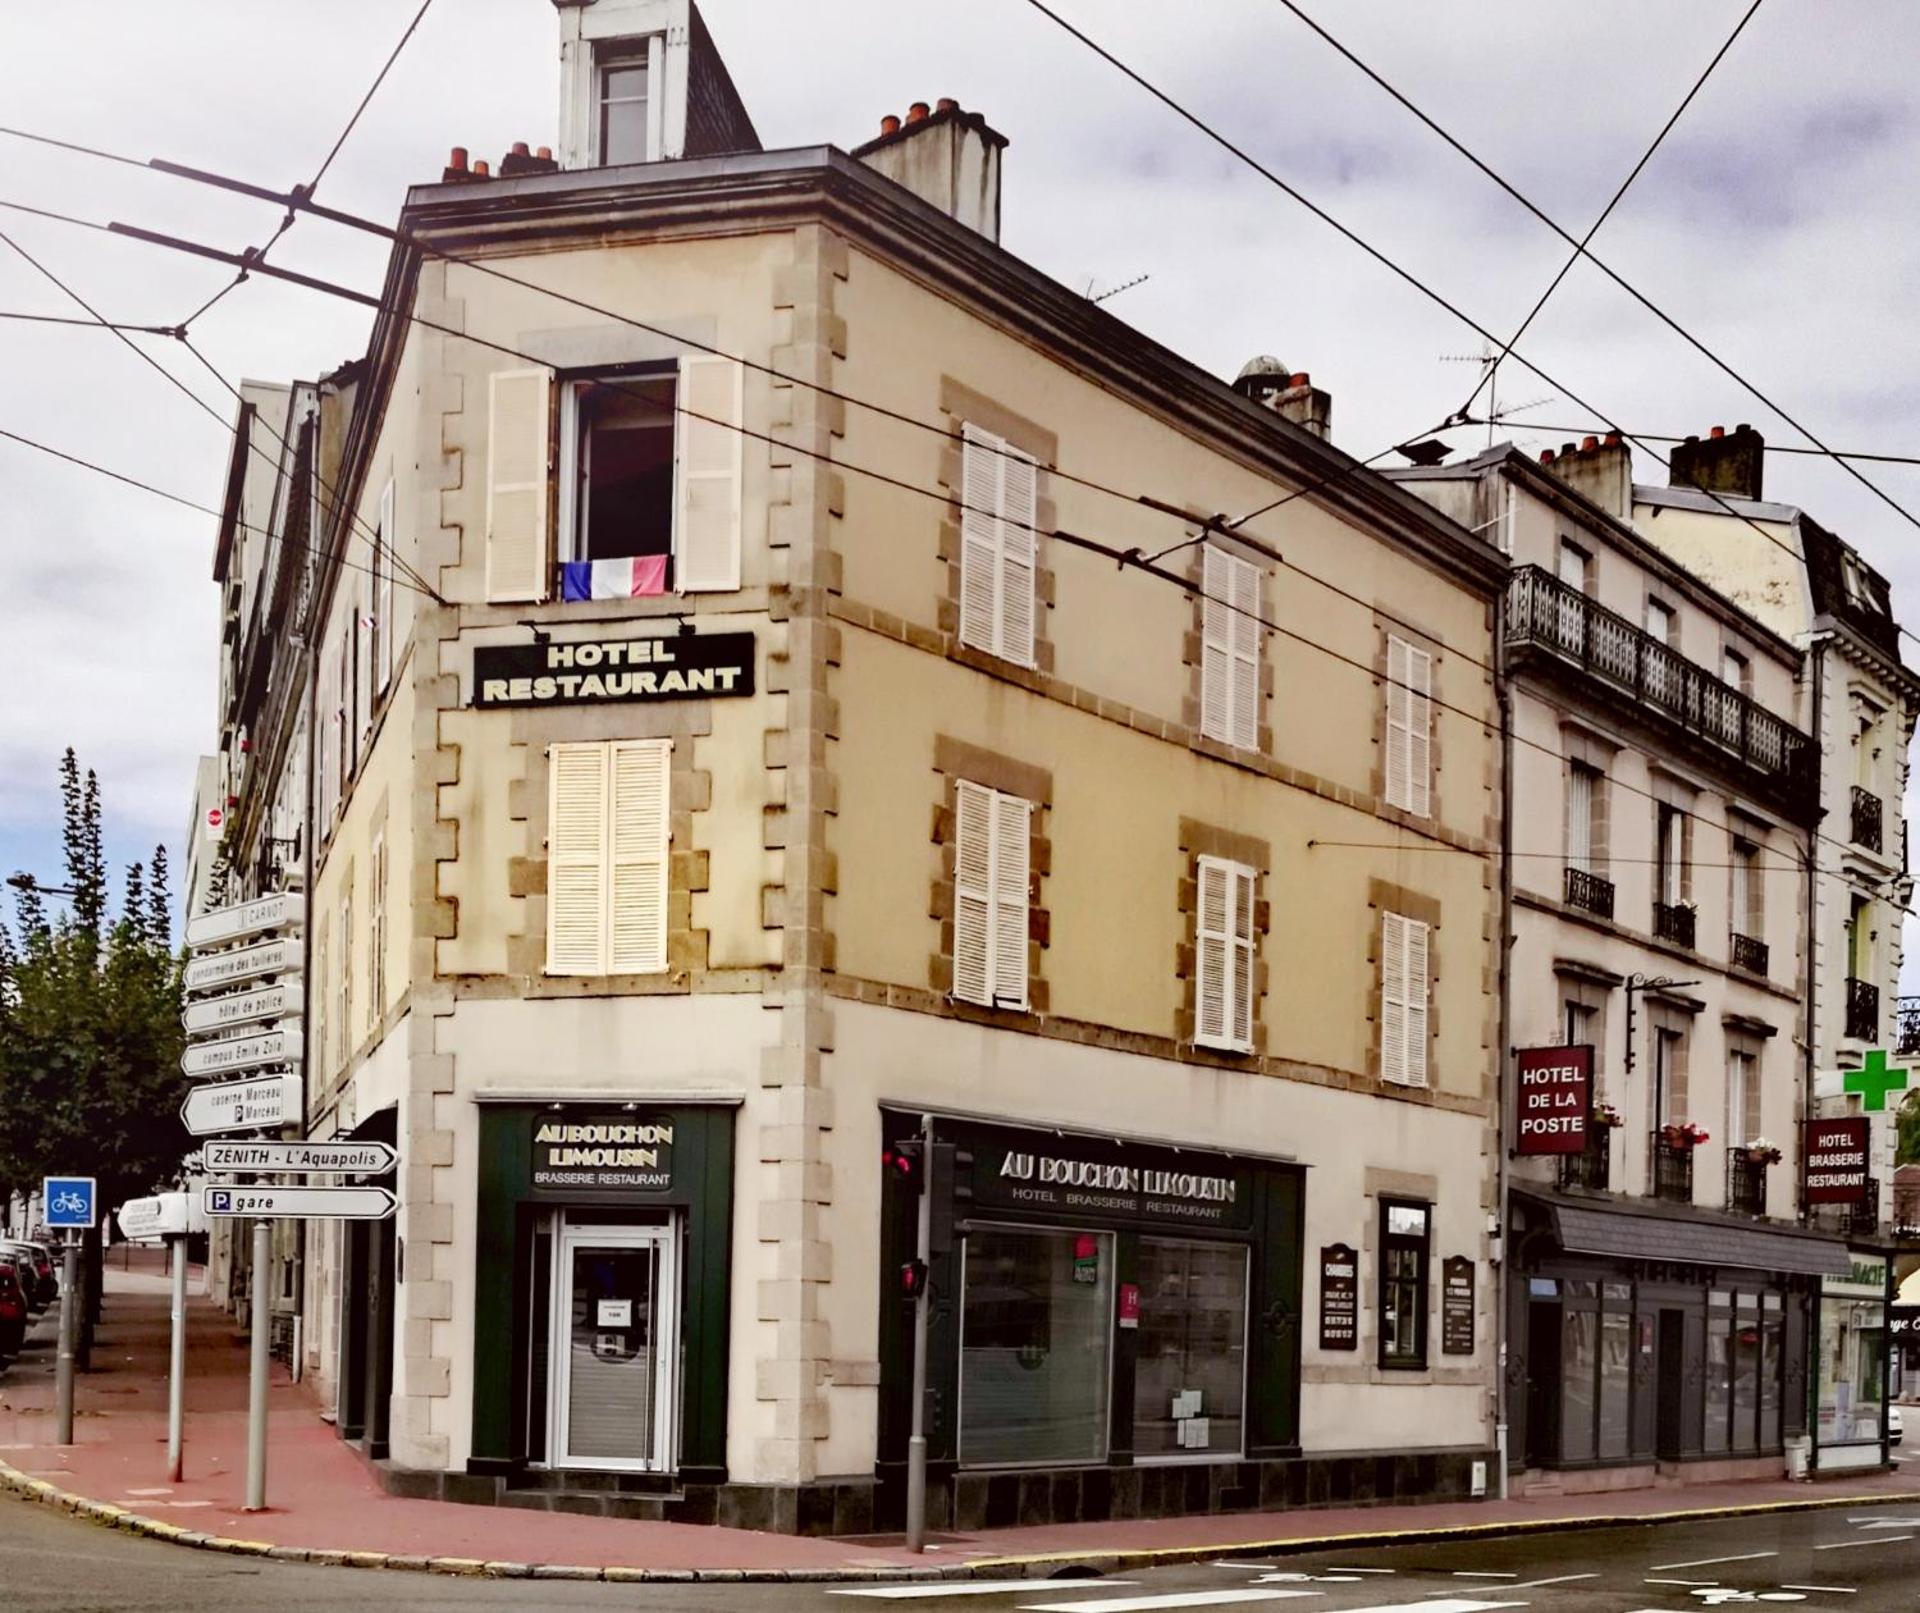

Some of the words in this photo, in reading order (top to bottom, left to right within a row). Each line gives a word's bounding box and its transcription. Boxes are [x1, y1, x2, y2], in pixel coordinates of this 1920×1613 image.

[548, 640, 675, 668] HOTEL
[483, 667, 742, 701] RESTAURANT
[249, 901, 284, 922] CARNOT
[242, 1001, 253, 1013] de
[255, 995, 282, 1013] police
[203, 1049, 233, 1066] campus
[262, 1038, 282, 1055] Zola
[1523, 1066, 1585, 1085] HOTEL
[246, 1087, 281, 1101] Marceau
[1528, 1093, 1550, 1108] DE
[1555, 1092, 1576, 1107] LA
[245, 1105, 281, 1119] Marceau
[1522, 1116, 1584, 1134] POSTE
[567, 1125, 673, 1145] BOUCHON
[1819, 1134, 1854, 1148] HOTEL
[213, 1146, 270, 1163] ZÉNITH
[549, 1148, 657, 1168] LIMOUSIN
[1809, 1152, 1864, 1168] BRASSERIE
[535, 1172, 595, 1184] BRASSERIE
[599, 1173, 670, 1185] RESTAURANT
[1000, 1151, 1034, 1179] AU
[1040, 1156, 1139, 1192] BOUCHON
[1144, 1169, 1235, 1203] LIMOUSIN
[1807, 1172, 1865, 1188] RESTAURANT
[235, 1198, 274, 1211] gare
[1013, 1188, 1057, 1202] HOTEL
[1066, 1193, 1137, 1210] BRASSERIE
[1146, 1201, 1222, 1219] RESTAURANT
